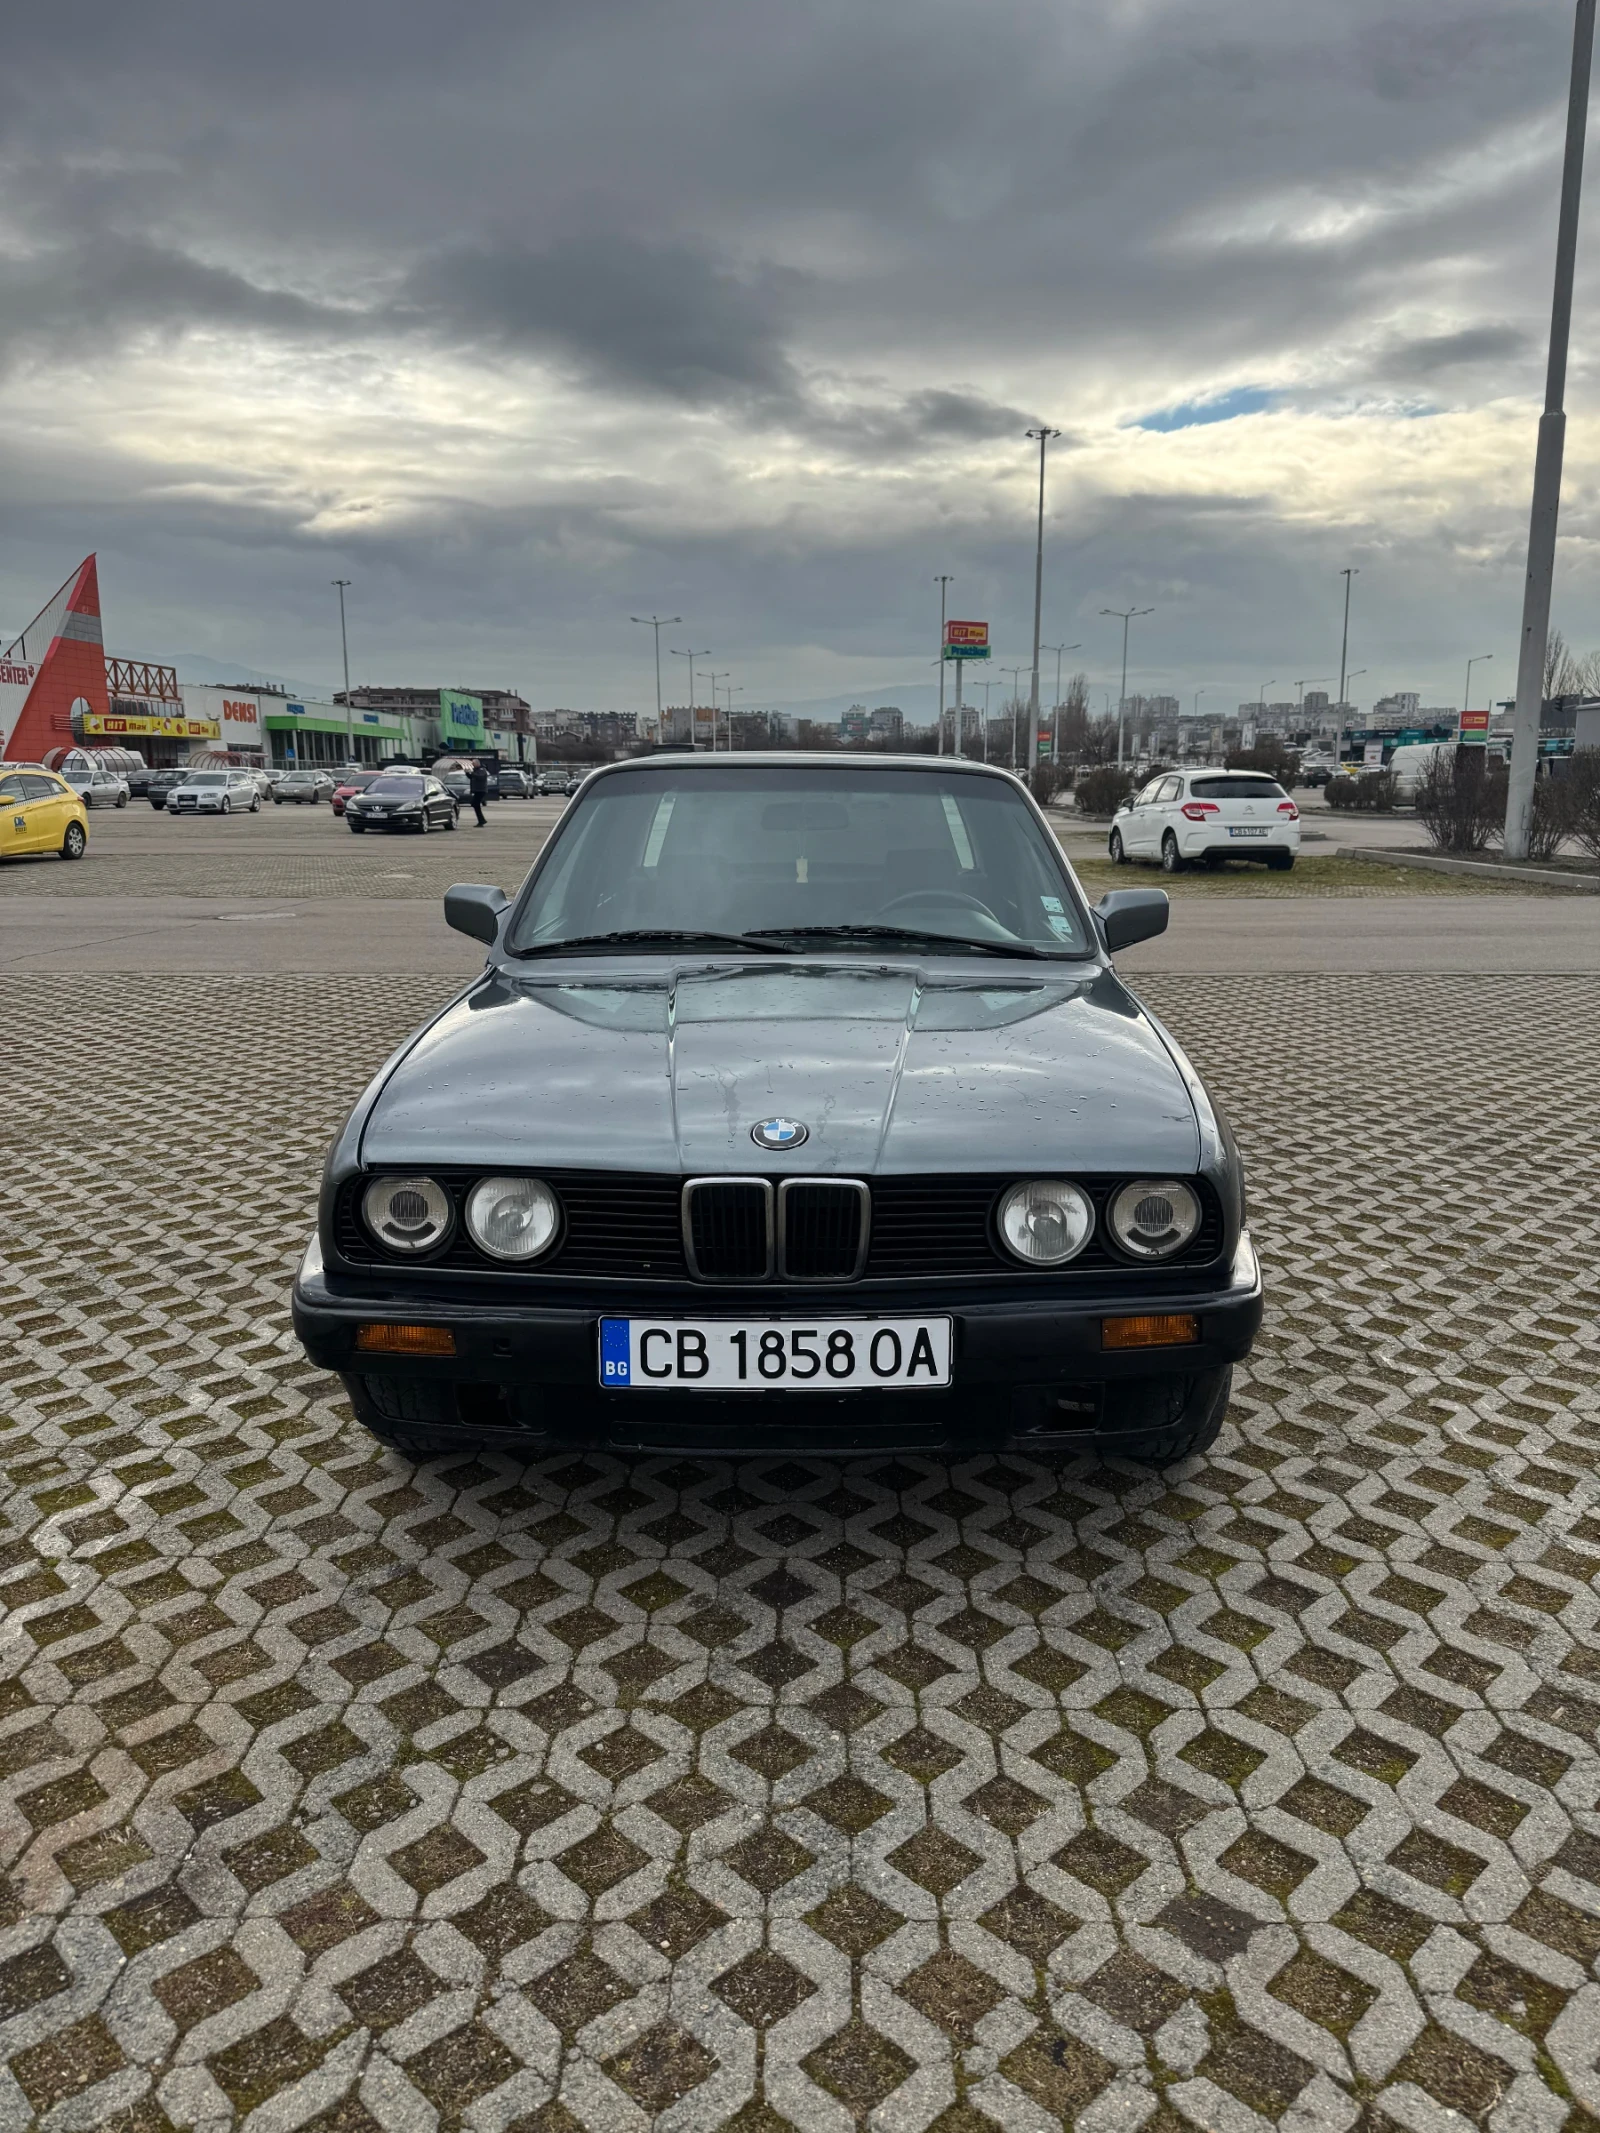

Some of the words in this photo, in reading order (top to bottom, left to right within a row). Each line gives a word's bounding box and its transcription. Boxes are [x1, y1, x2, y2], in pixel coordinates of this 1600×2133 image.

[0, 664, 29, 685] ENTER
[223, 700, 257, 723] DENSI
[106, 720, 124, 730] HIT
[129, 722, 147, 731] Max
[189, 724, 199, 733] HIT
[639, 1328, 710, 1379] CB
[730, 1328, 856, 1380] 1858
[605, 1361, 628, 1376] BG
